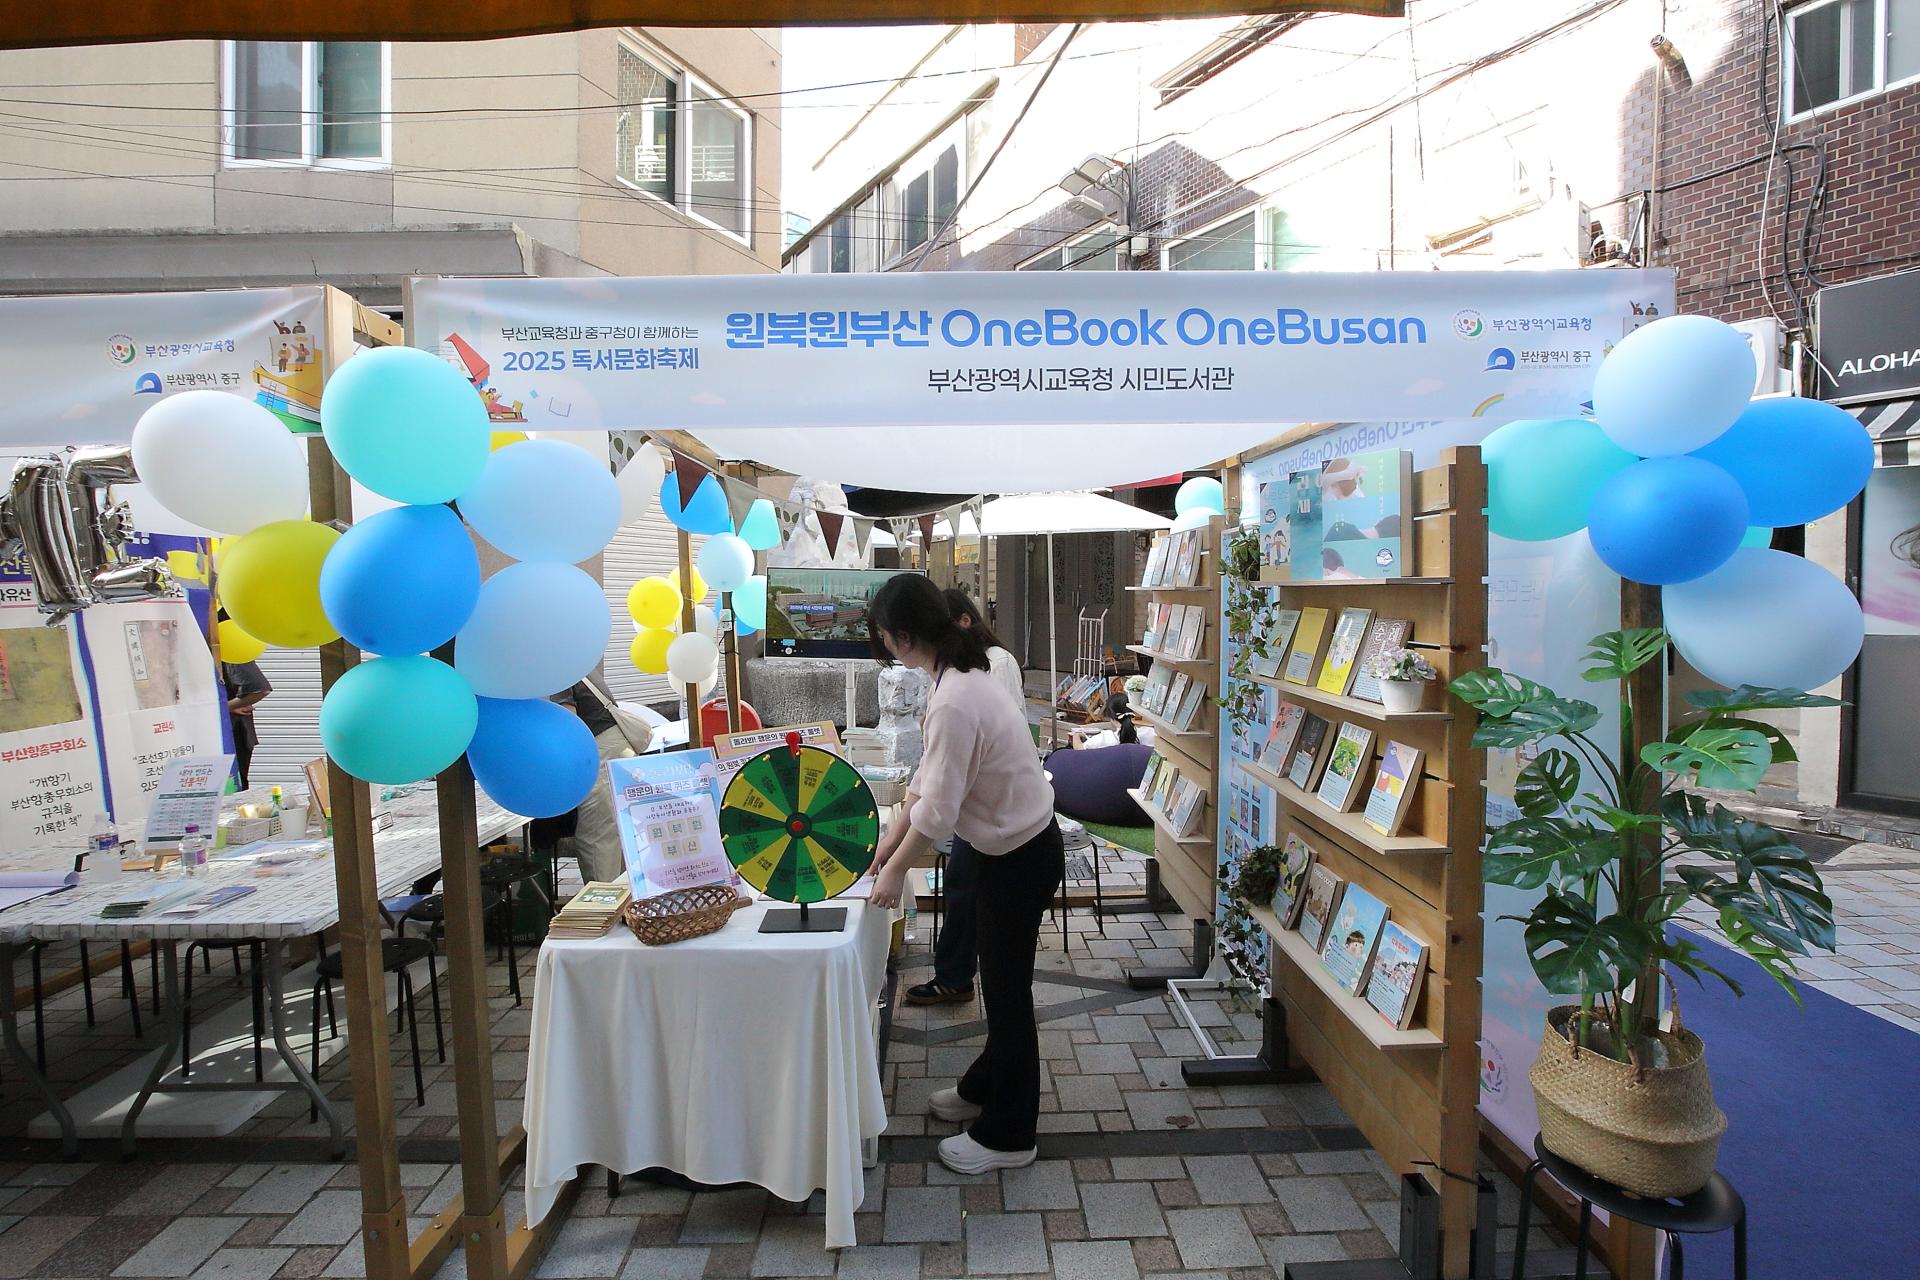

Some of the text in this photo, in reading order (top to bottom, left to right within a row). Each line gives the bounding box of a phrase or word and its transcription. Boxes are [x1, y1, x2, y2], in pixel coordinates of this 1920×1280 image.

[501, 324, 700, 342] 부산교육청과 중구청이 함께하는
[726, 307, 1427, 350] 원북원부산 OneBook OneBusan
[1492, 317, 1592, 331] 부산광역시교육청
[145, 339, 234, 357] 부산광역시교육청
[503, 346, 700, 371] 2025 독서문화축제
[1521, 351, 1592, 364] 부산광역시 중구
[166, 372, 241, 386] 부산광역시 중구
[927, 366, 1235, 393] 부산광역시교육청 시민도서관
[1, 737, 88, 763] 부산항총무회소
[11, 782, 93, 811] 부산항총무회소의
[41, 802, 73, 819] 규칙을
[33, 819, 67, 836] 기록한
